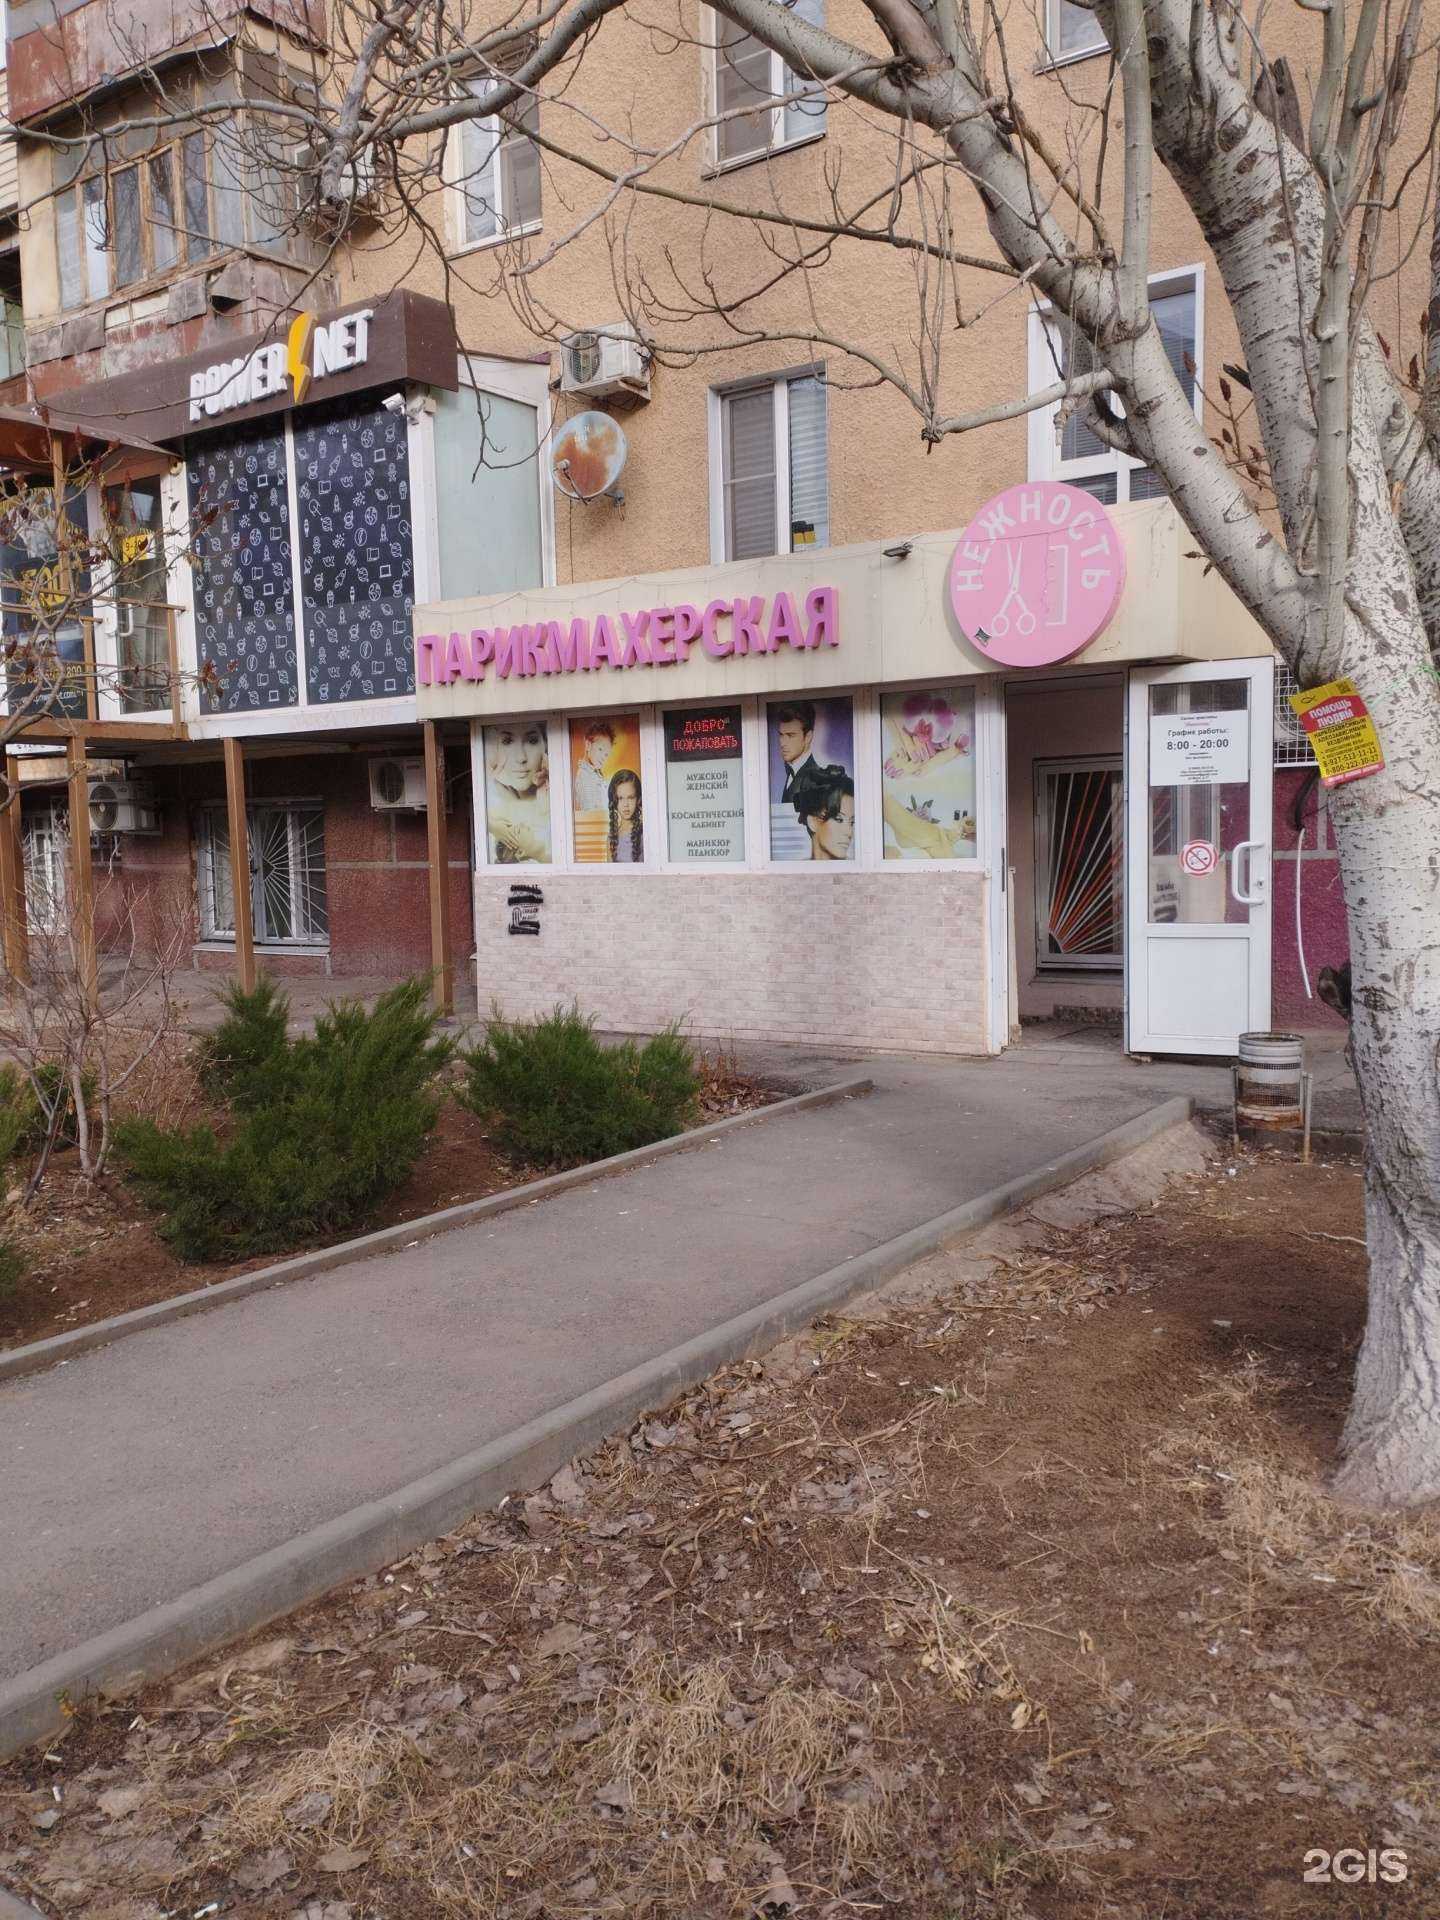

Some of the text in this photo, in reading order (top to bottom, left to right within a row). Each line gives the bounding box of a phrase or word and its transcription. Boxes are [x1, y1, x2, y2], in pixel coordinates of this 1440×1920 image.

[190, 309, 374, 422] POWER NET
[956, 490, 1112, 592] НЕЖНОСТЬ
[417, 586, 840, 686] ПАРИКМАХЕРСКАЯ
[1309, 699, 1352, 719] ПОМОЩЬ
[683, 718, 725, 735] ДОБРО
[673, 736, 738, 752] ПОЖАЛОВАТЬ
[1167, 741, 1189, 750] 8:00
[1200, 739, 1229, 748] 20:00
[686, 771, 728, 781] МУЖСКОЙ
[686, 781, 728, 791] ЖЕНСКИЙ
[672, 809, 744, 820] КОСМЕТИЧЕСКИЙ
[691, 820, 726, 829] КАБИНЕТ
[686, 839, 731, 847] МАНИКЮР
[688, 849, 730, 857] ПЕДИКЮР
